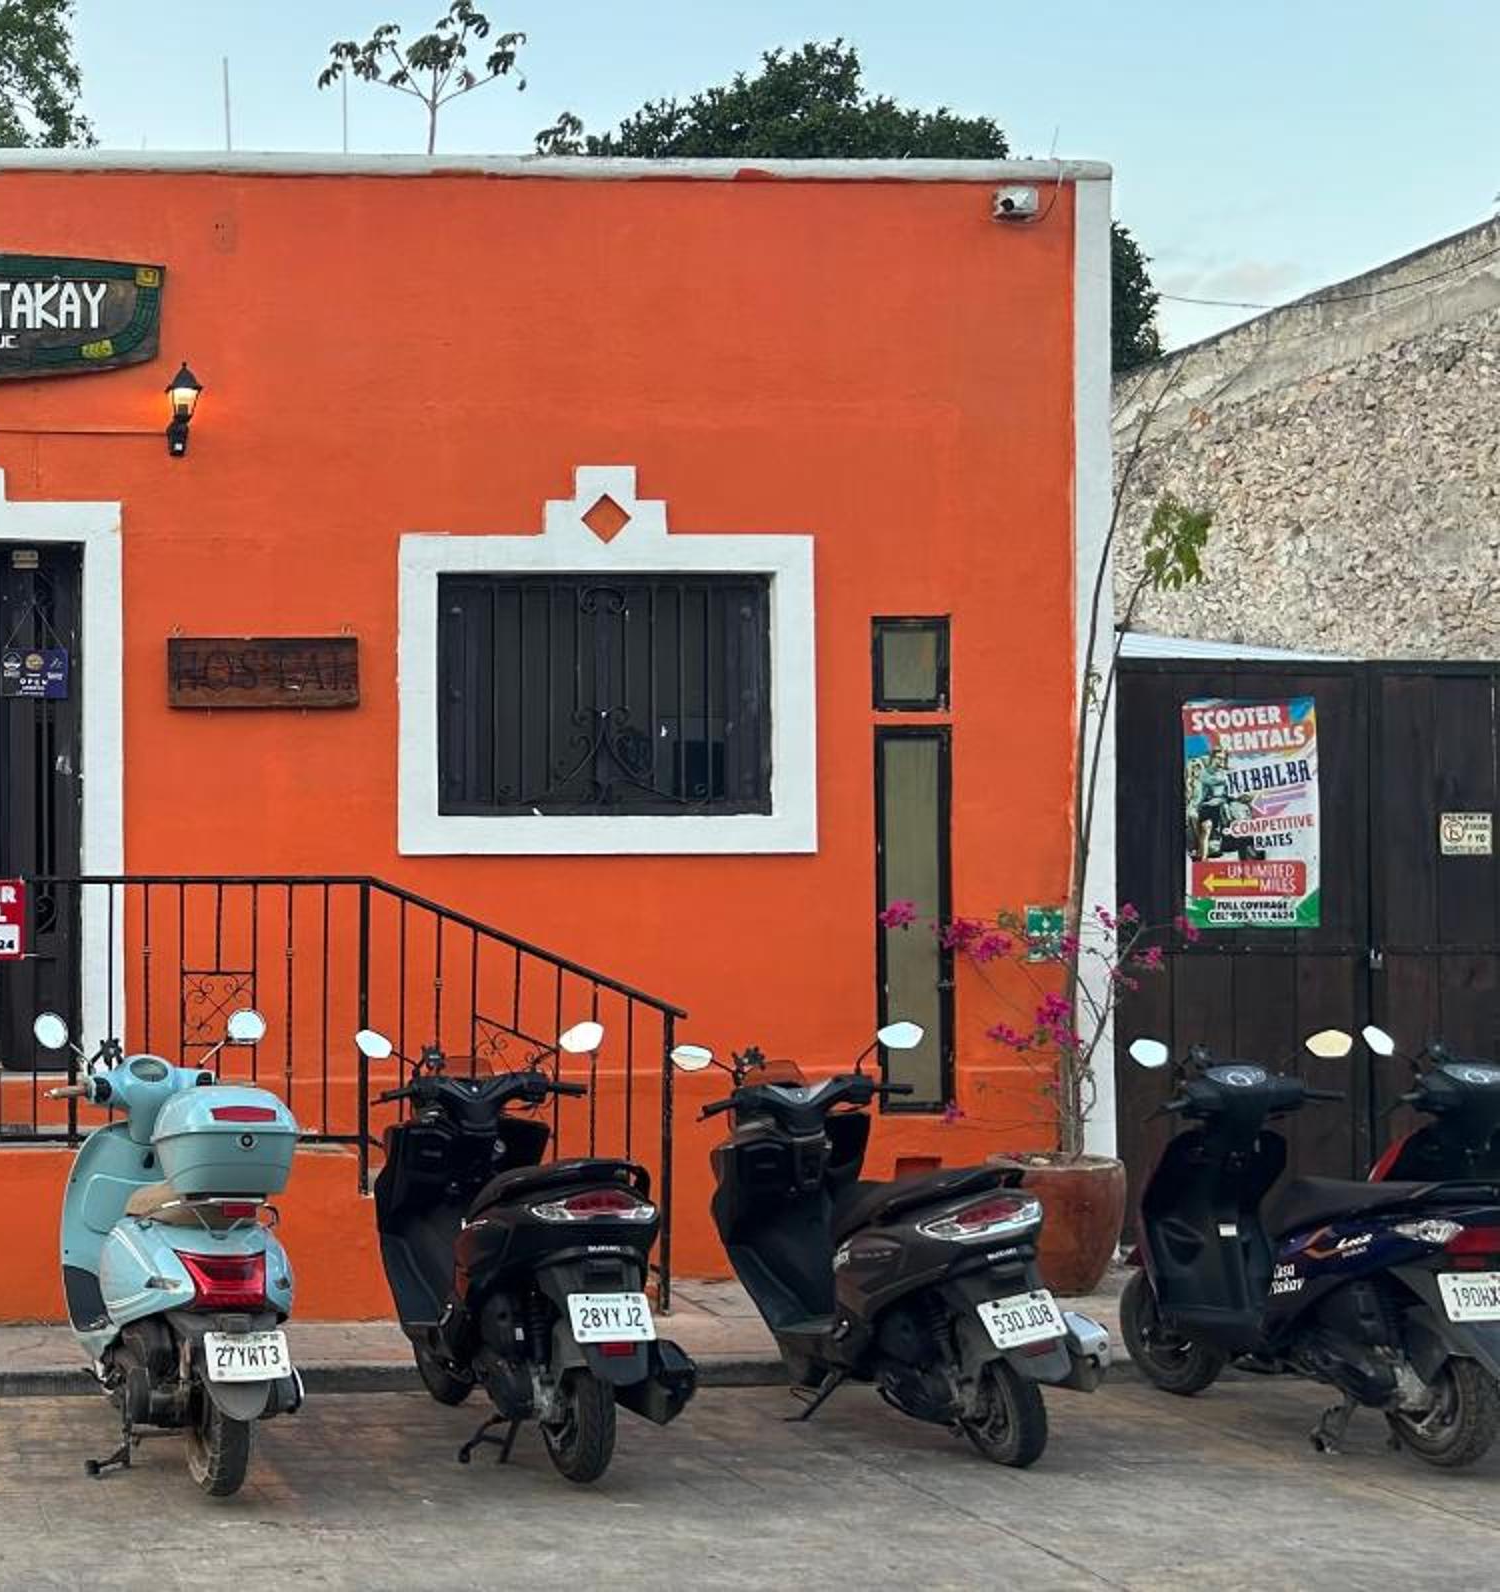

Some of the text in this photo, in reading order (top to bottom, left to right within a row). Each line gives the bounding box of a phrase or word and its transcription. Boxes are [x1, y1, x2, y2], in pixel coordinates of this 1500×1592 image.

[1191, 705, 1282, 732] SCOOTER
[1219, 725, 1306, 752] RENTALS
[1231, 814, 1315, 835] COMPETITIVE
[1255, 832, 1294, 849] RATES
[1227, 864, 1296, 879] UNLIMITED
[1259, 879, 1297, 893] MILES
[1217, 901, 1288, 910] FULL COVERAGE
[1451, 1285, 1500, 1308] 19DHX
